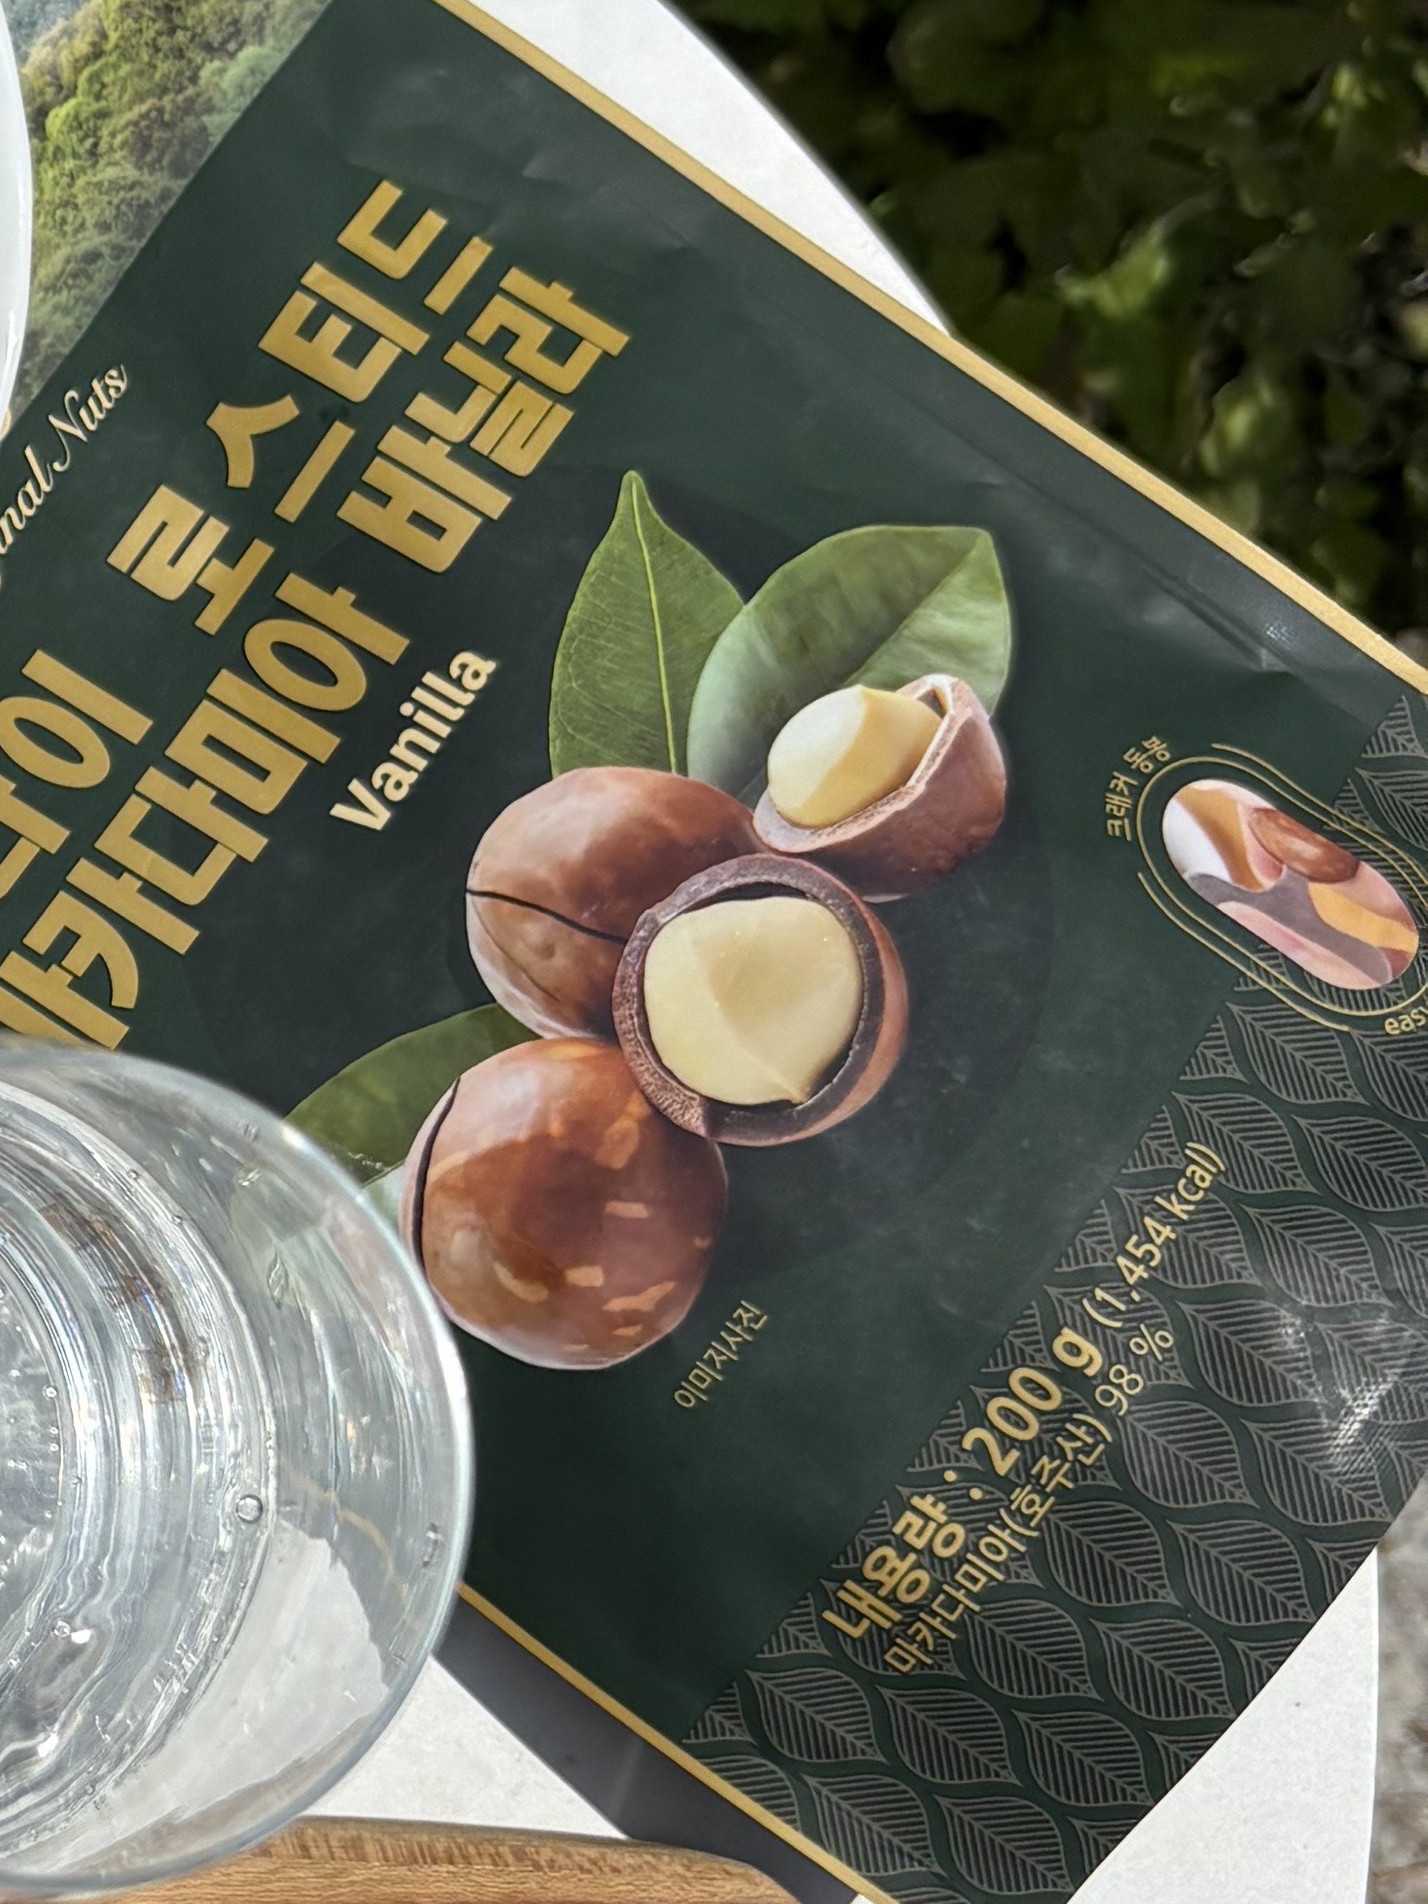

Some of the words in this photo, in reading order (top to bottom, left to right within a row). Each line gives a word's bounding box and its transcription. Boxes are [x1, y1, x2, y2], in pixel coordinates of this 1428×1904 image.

[48, 364, 128, 472] Nuts
[107, 179, 493, 636] 로스티드
[336, 266, 630, 575] 바닐라
[329, 646, 496, 832] Vanilla
[1105, 771, 1139, 842] 크래커
[1123, 735, 1172, 775] 동봉
[674, 1300, 768, 1408] 이미지사진
[822, 1493, 966, 1639] 내용량
[960, 1366, 1064, 1477] 200
[1051, 1326, 1104, 1377] g
[1082, 1212, 1177, 1330] (1,454
[1154, 1141, 1225, 1224] kcal)
[883, 1411, 1115, 1674] 마카다미아(호주산)
[1094, 1363, 1145, 1417] 98
[1129, 1322, 1175, 1362] %
